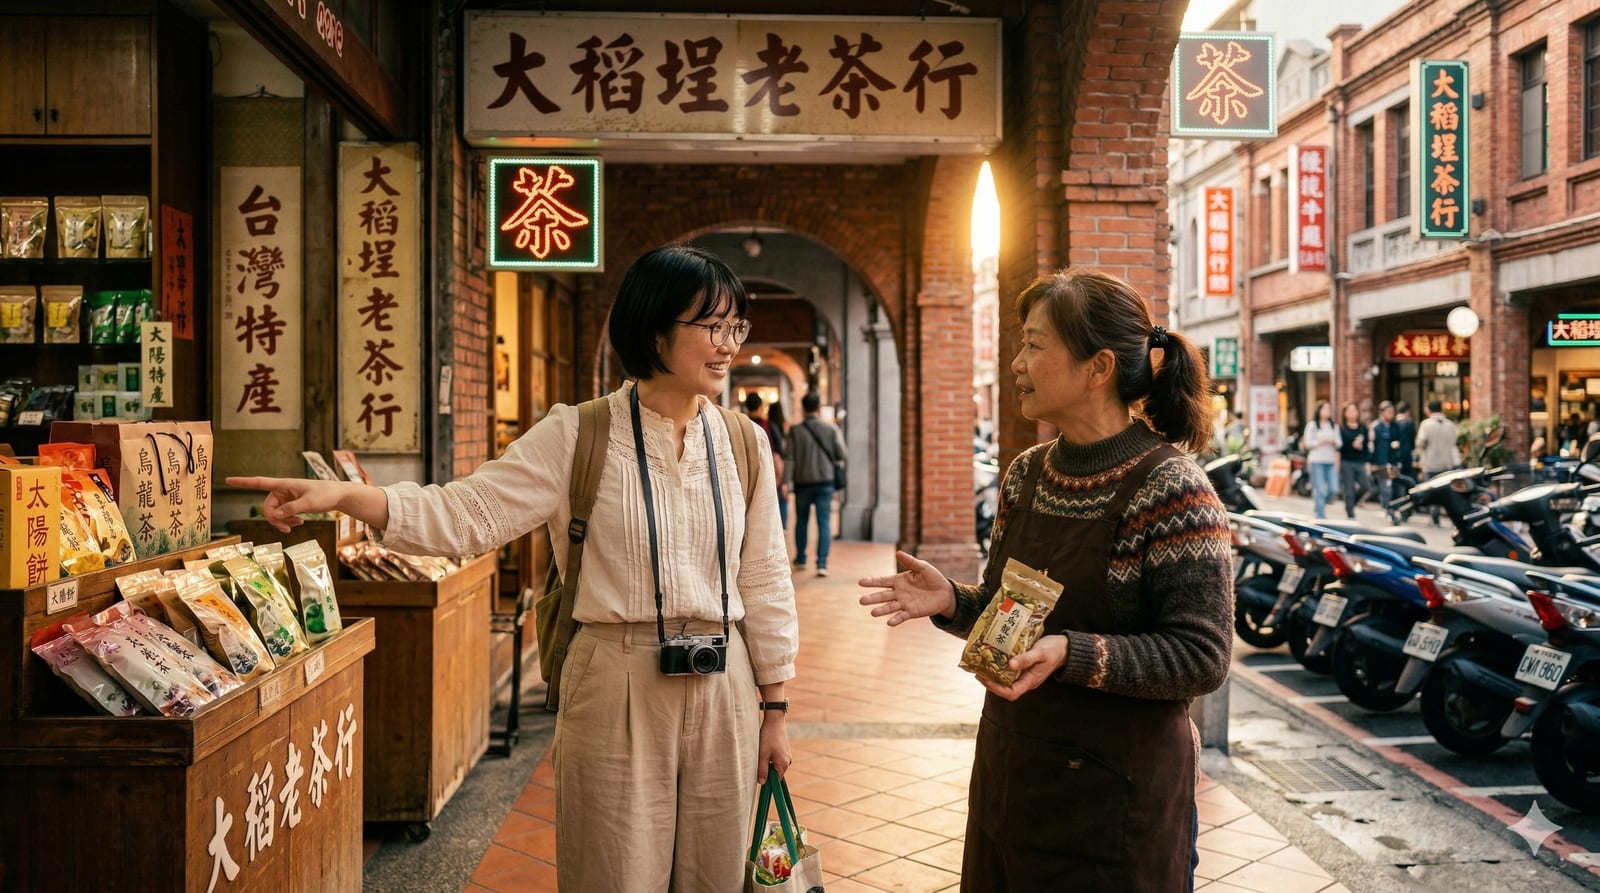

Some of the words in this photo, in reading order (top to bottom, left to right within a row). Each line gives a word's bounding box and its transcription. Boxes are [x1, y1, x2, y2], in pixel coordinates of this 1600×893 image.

[487, 32, 977, 119] 大稻埕老茶行
[1187, 41, 1264, 125] 茶
[1430, 68, 1460, 229] 大稻埕茶行
[501, 165, 589, 258] 茶
[236, 185, 287, 414] 台灣特產
[357, 157, 403, 437] 大稻埕老茶行
[26, 478, 49, 587] 太陽餅
[136, 448, 155, 543] 烏龍茶
[167, 448, 183, 538] 烏龍茶
[194, 444, 207, 533] 烏龍茶
[207, 703, 357, 893] 大稻老茶行
